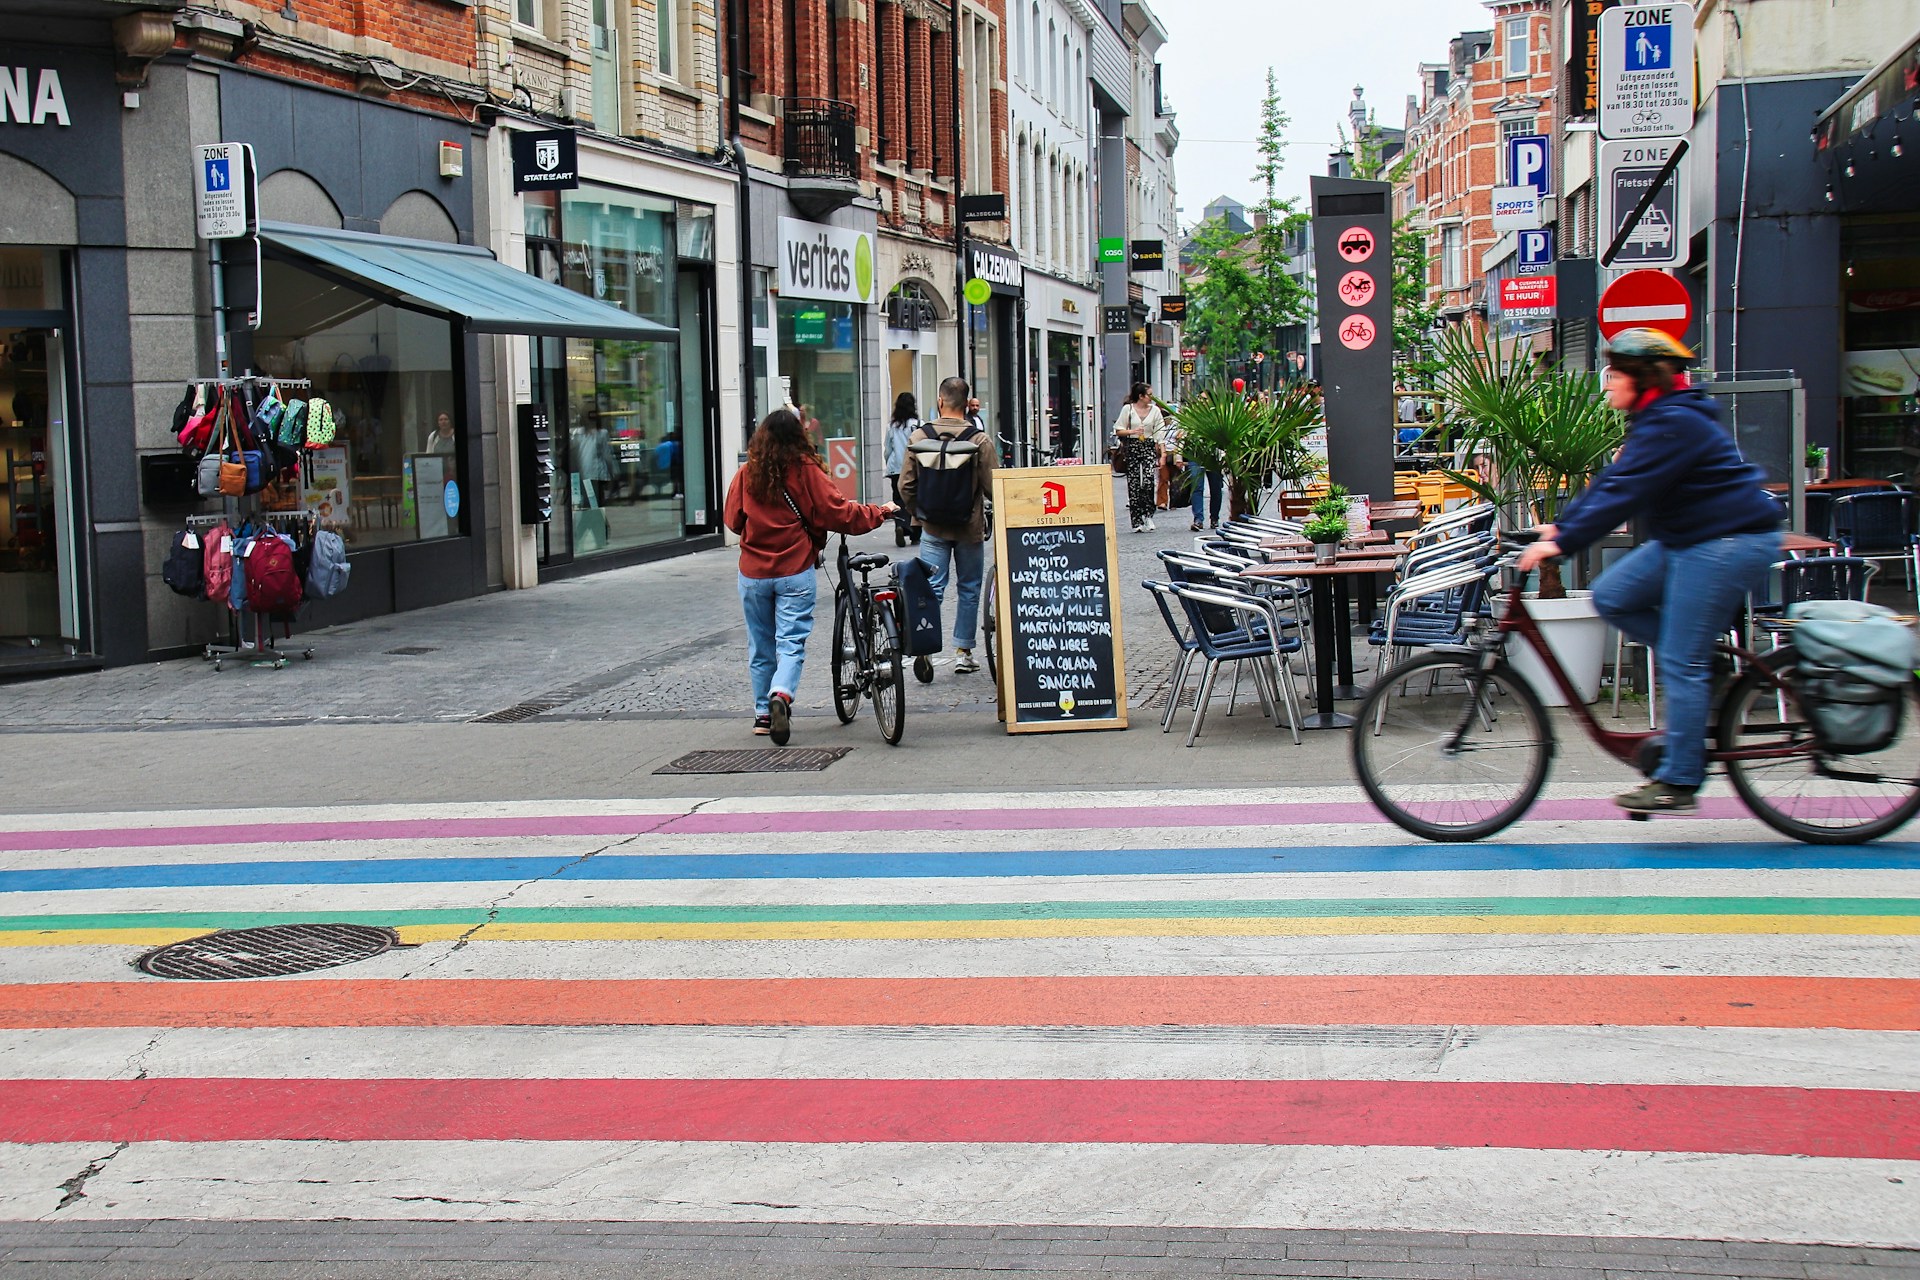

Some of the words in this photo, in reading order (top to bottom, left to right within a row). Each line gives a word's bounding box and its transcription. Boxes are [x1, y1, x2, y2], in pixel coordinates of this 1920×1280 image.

[1624, 9, 1672, 26] ZONE
[526, 74, 548, 89] ANNO
[1620, 71, 1674, 82] Uitgezonderd
[0, 66, 71, 125] NA
[1660, 98, 1688, 106] 20.30u
[204, 148, 229, 160] ZONE
[1623, 148, 1668, 162] ZONE
[1517, 143, 1542, 186] P
[1496, 201, 1533, 209] SPORTS
[1527, 234, 1545, 261] P
[787, 233, 850, 292] veritas
[974, 250, 1022, 287] CALZEDONIA
[1022, 530, 1086, 546] COCKTAILS
[1012, 571, 1038, 584] LAZY
[1041, 570, 1062, 583] RED
[1021, 586, 1059, 599] APEROL
[1061, 585, 1104, 600] SPRITZ
[1017, 602, 1064, 617] MOSCOW
[1068, 604, 1103, 617] MULE
[1028, 637, 1056, 651] CUBA
[1060, 638, 1090, 652] LIBRE
[1057, 656, 1097, 671] COLADA
[1038, 673, 1095, 690] SANGRIA
